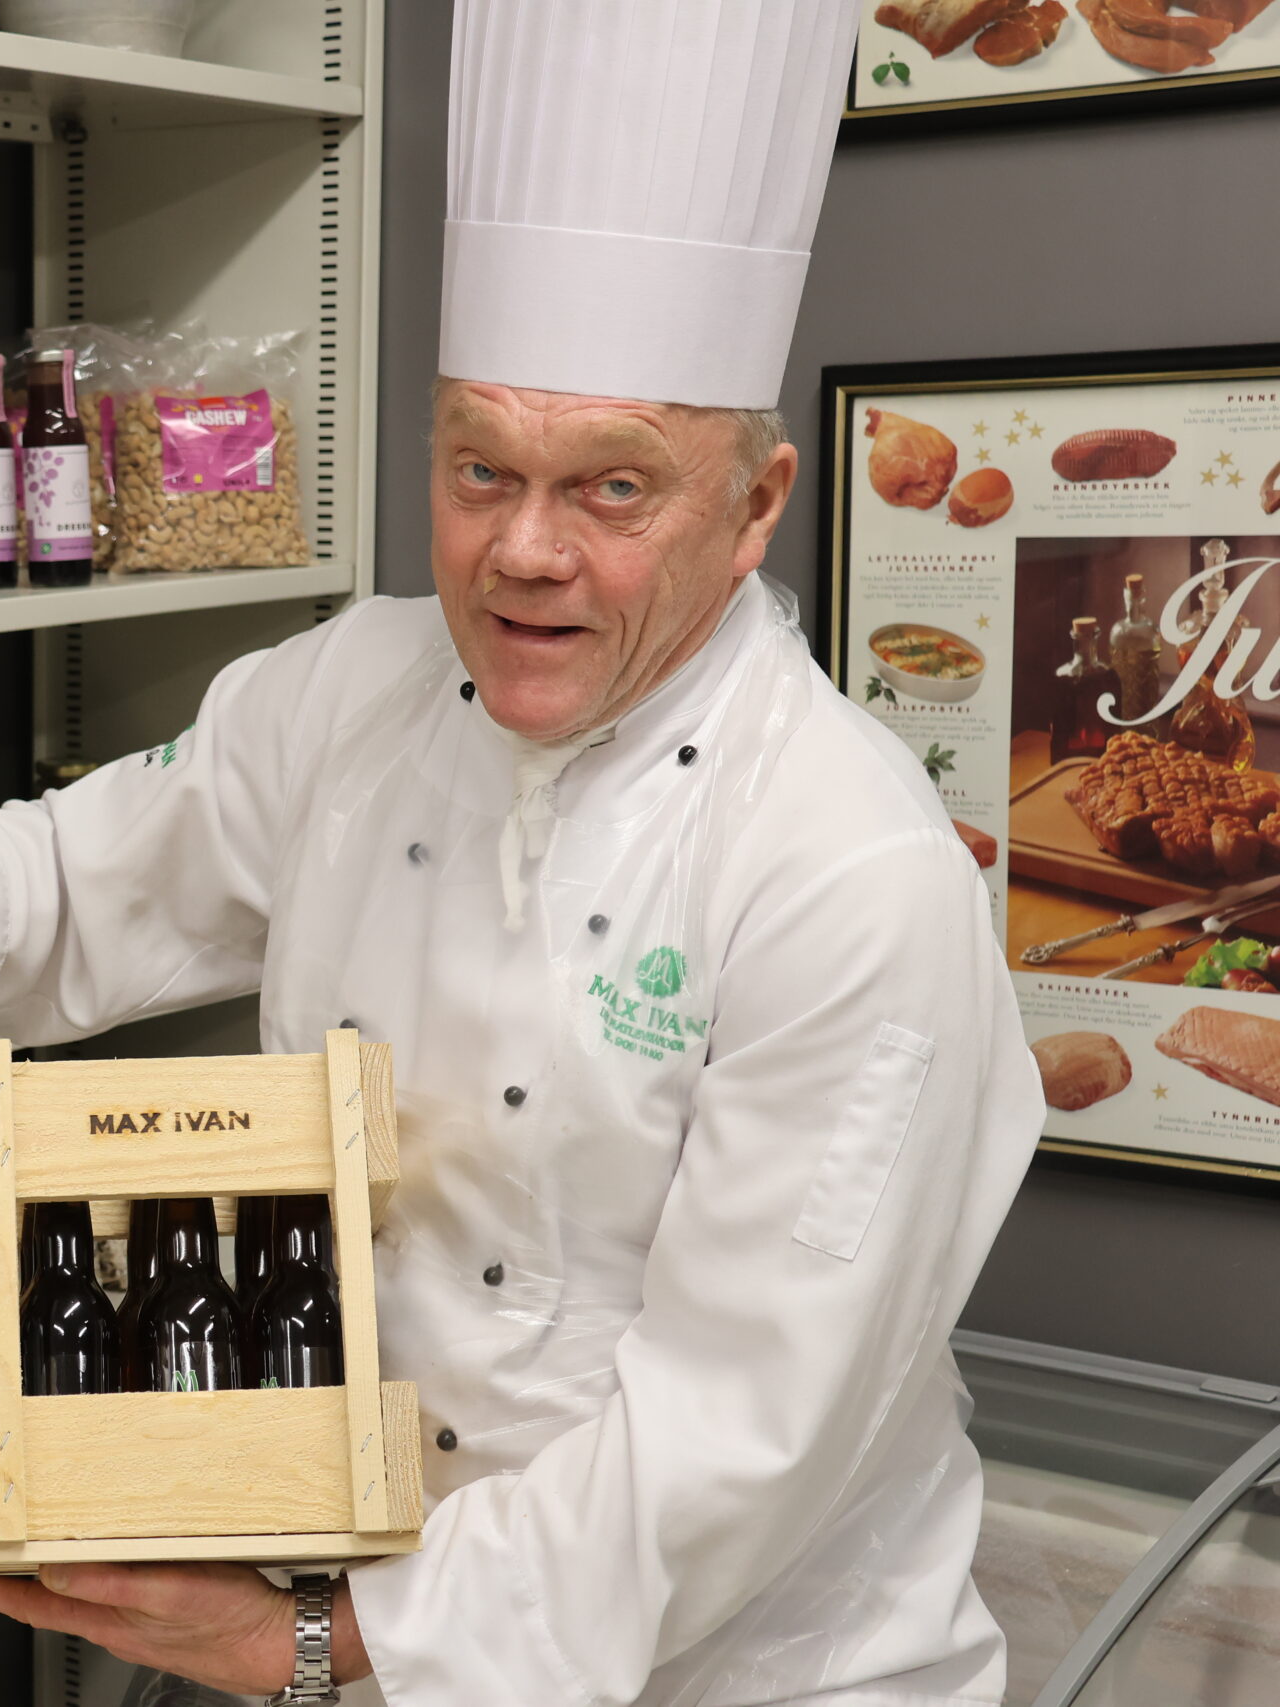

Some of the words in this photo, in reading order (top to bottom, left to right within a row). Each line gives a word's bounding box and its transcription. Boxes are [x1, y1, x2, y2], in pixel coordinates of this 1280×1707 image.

[185, 409, 247, 426] CASHEW
[1053, 482, 1171, 491] REINSDYRSTEK
[89, 1112, 162, 1135] MAX
[174, 1110, 251, 1132] IVAN
